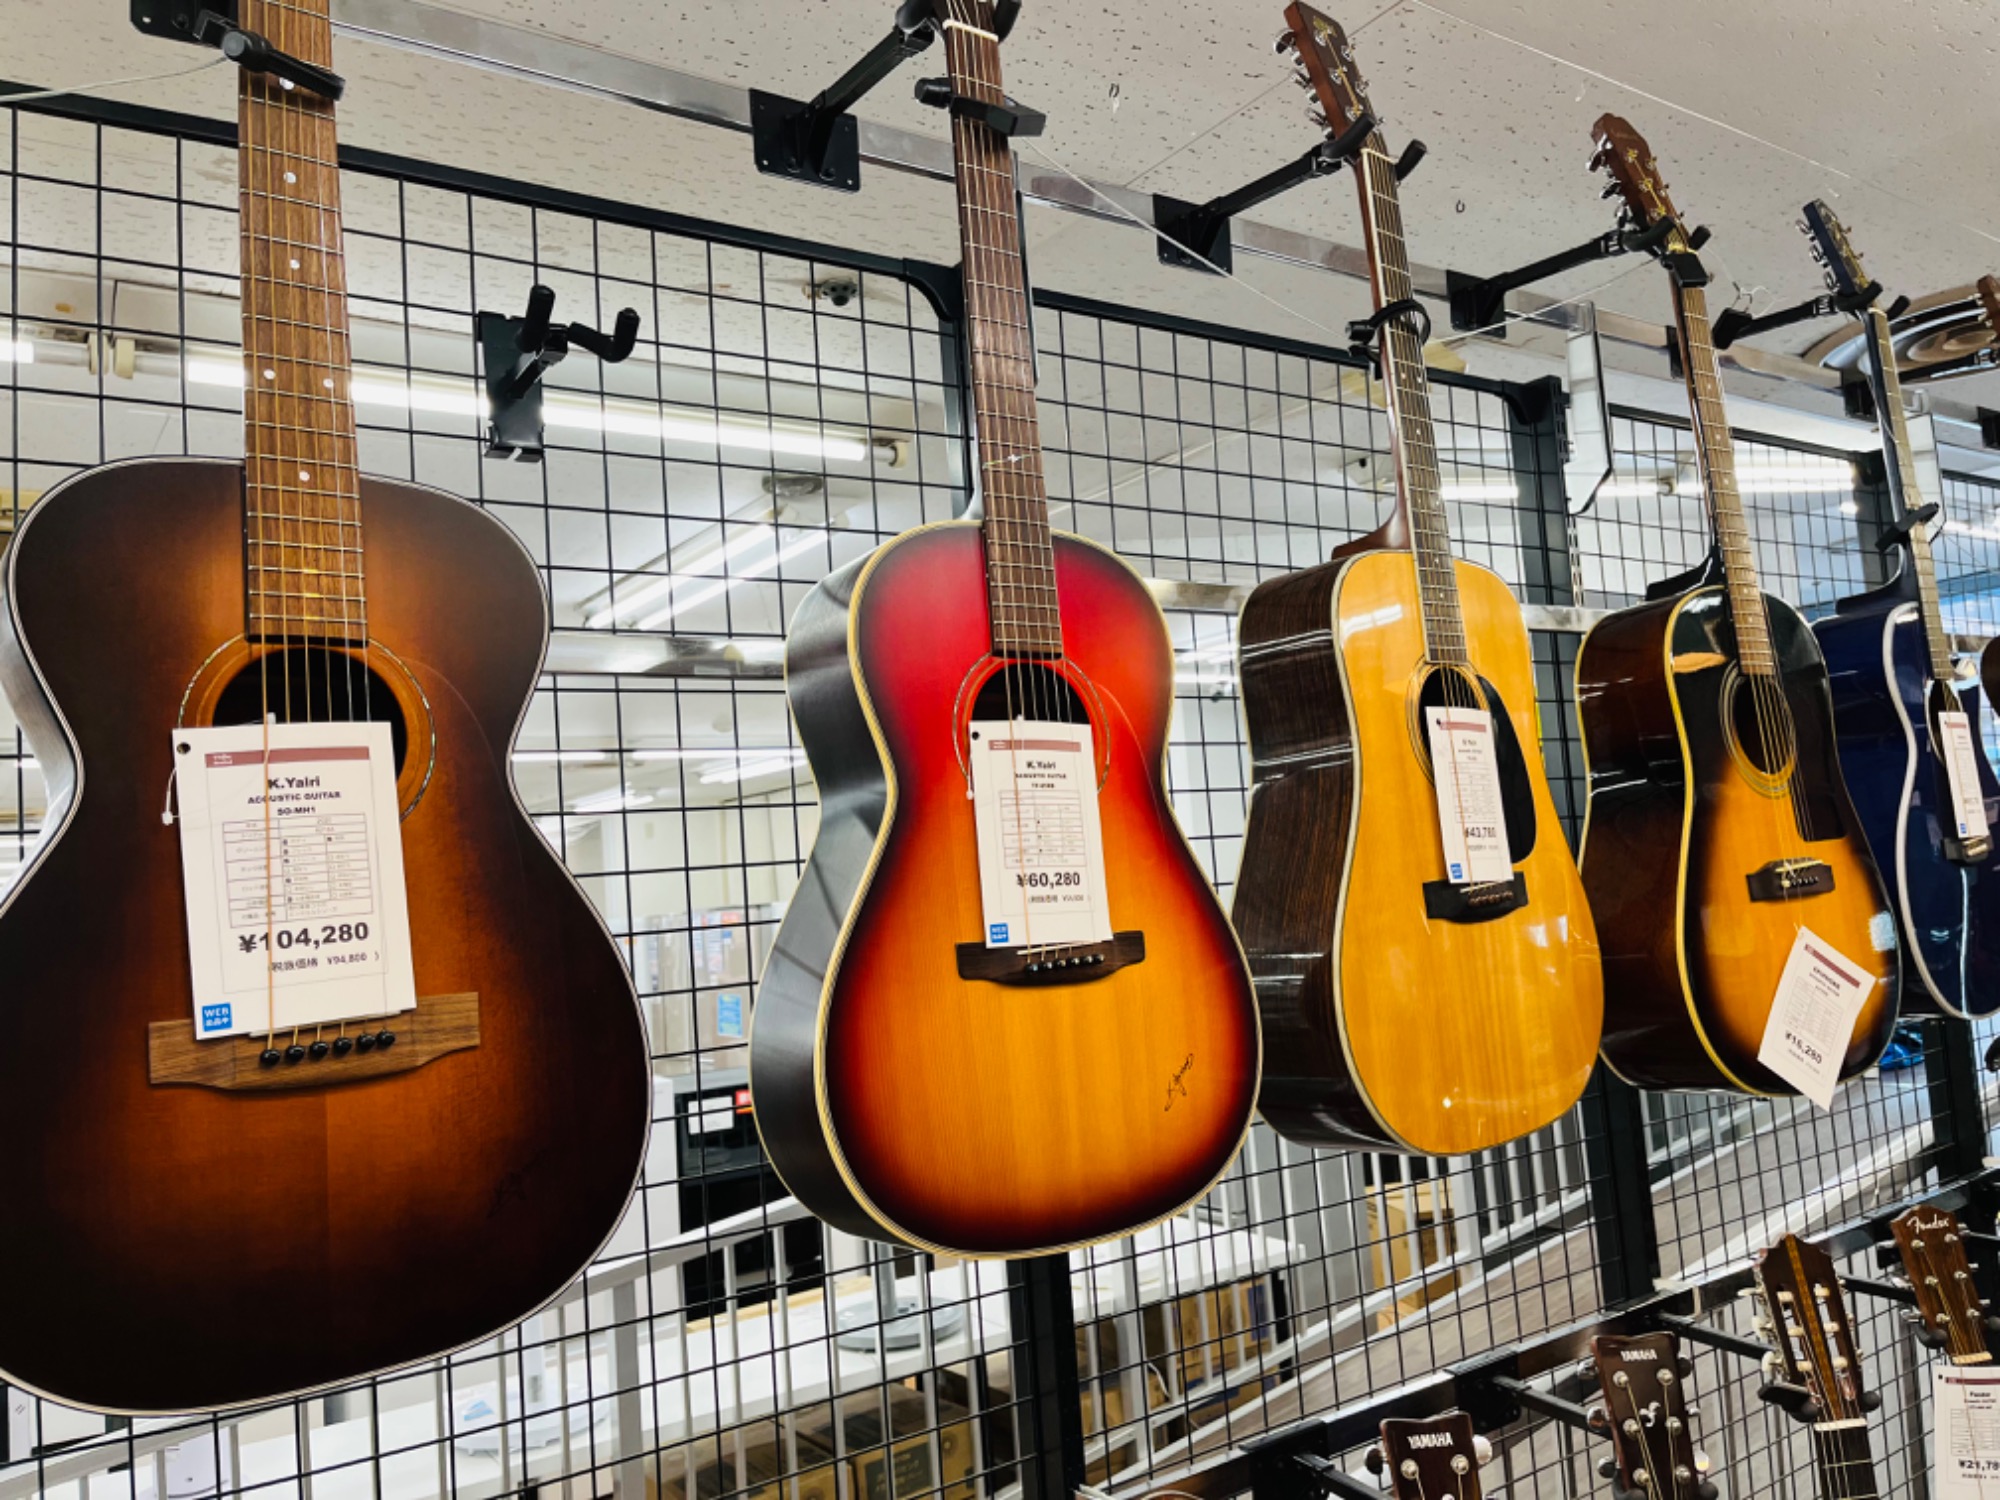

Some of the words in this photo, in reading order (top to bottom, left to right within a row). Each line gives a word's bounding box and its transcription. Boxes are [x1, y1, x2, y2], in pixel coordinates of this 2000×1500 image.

[267, 776, 321, 790] K.Yairi
[304, 791, 342, 801] GUITAR
[1016, 872, 1081, 889] ¥60,280
[238, 922, 369, 953] ¥104,280
[1906, 1213, 1950, 1235] Fender
[1620, 1349, 1658, 1362] YAMAHA
[1406, 1432, 1454, 1449] YAMAHA
[1958, 1459, 2000, 1472] ¥21,78
